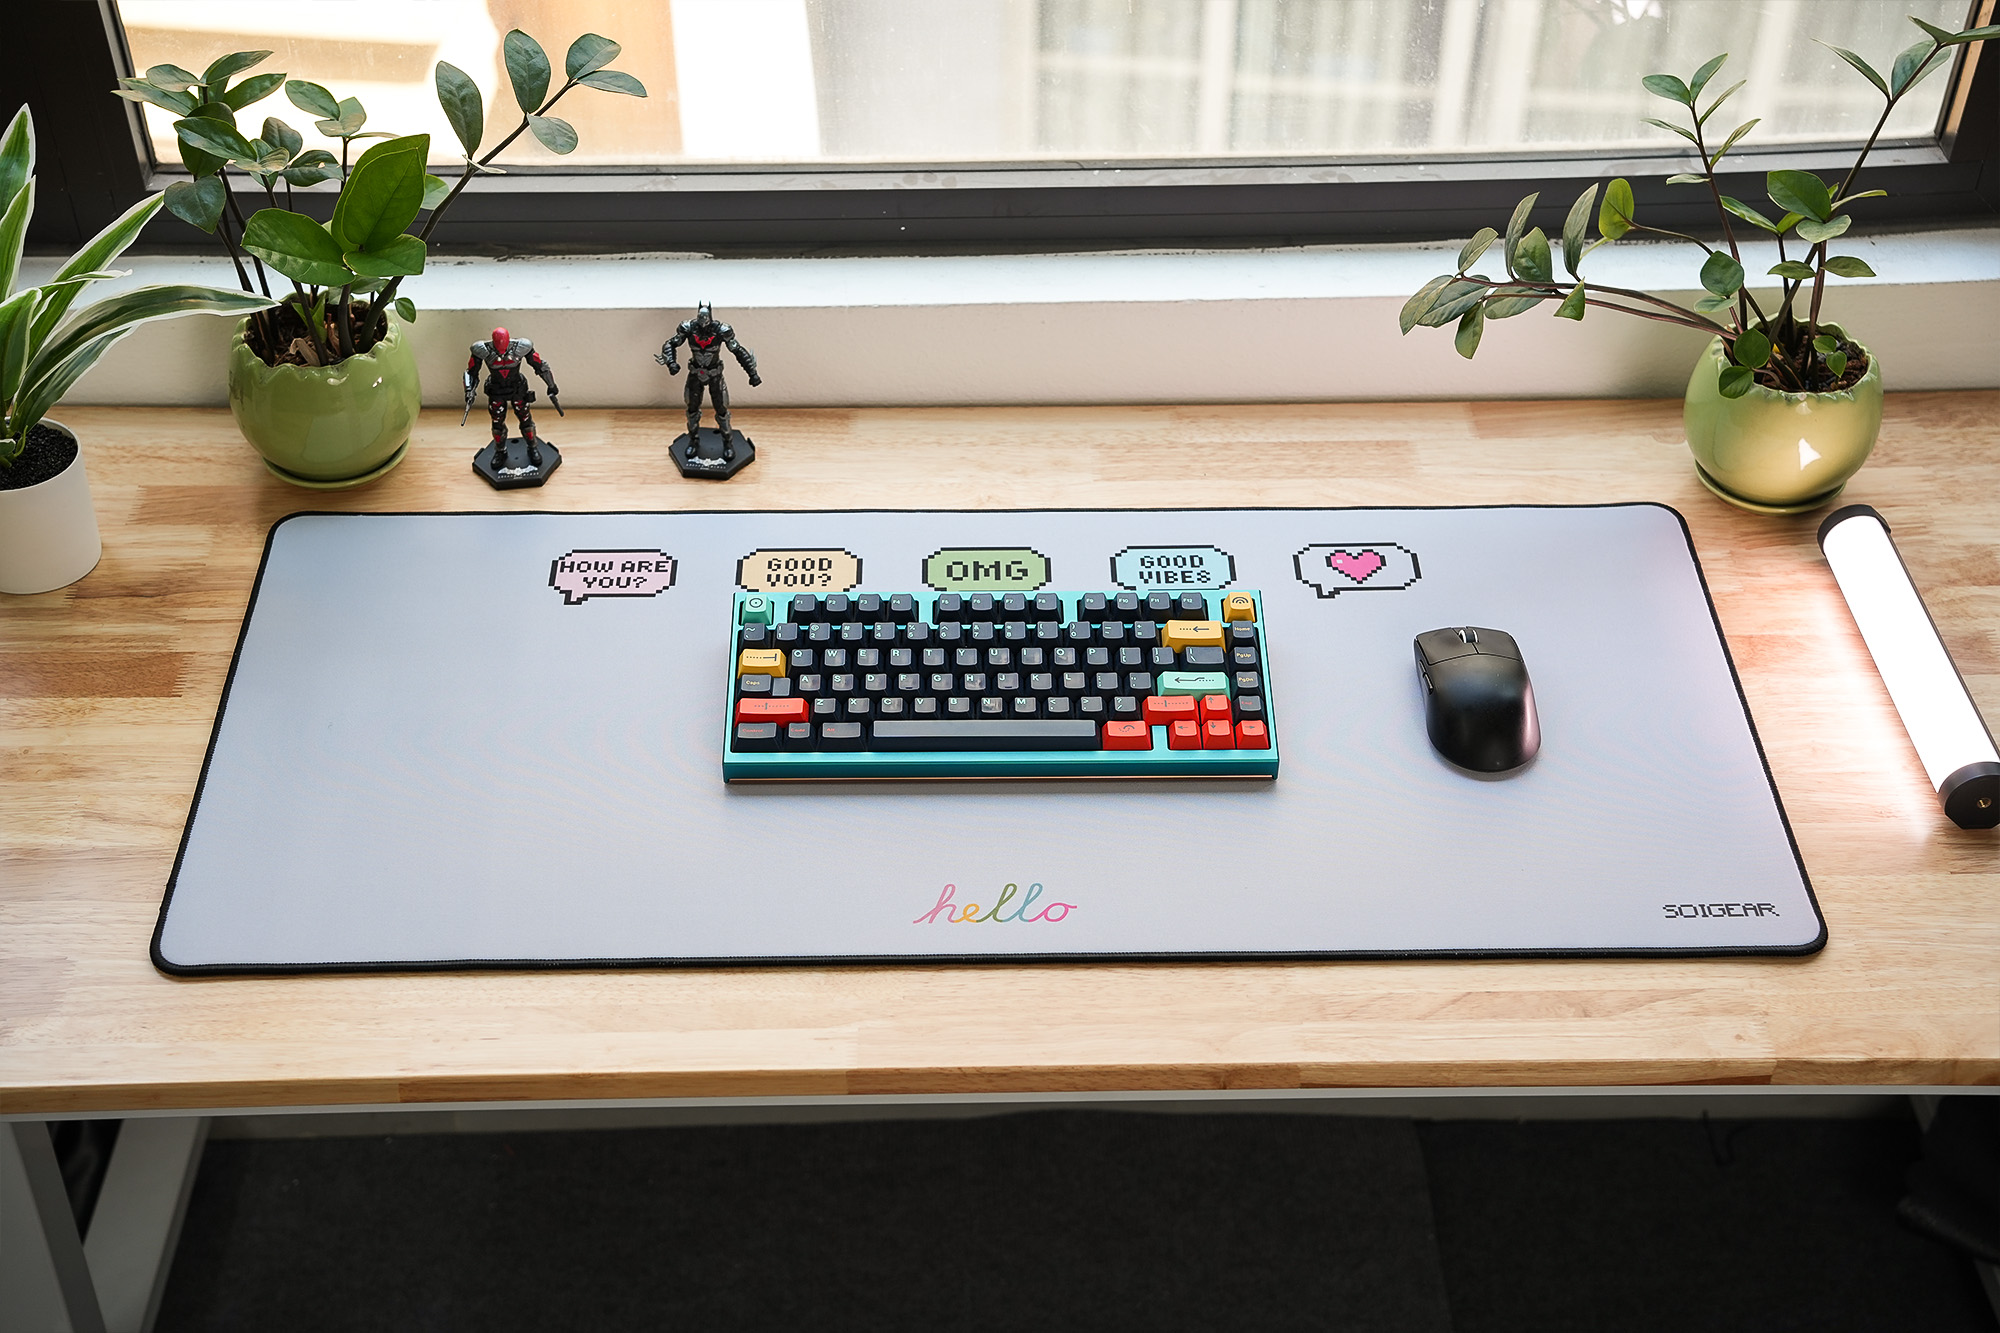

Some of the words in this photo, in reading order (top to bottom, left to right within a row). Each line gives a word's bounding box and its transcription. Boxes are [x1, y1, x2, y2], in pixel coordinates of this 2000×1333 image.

[560, 561, 613, 573] HOW
[621, 561, 669, 573] ARE
[768, 558, 832, 571] GOOD
[1140, 555, 1204, 568] GOOD
[946, 561, 1028, 580] OMG
[1139, 570, 1211, 584] VIBES
[583, 577, 647, 588] YOU?
[767, 574, 831, 587] YOU?
[913, 883, 1077, 923] hello
[1662, 903, 1780, 918] SOIGEAR
